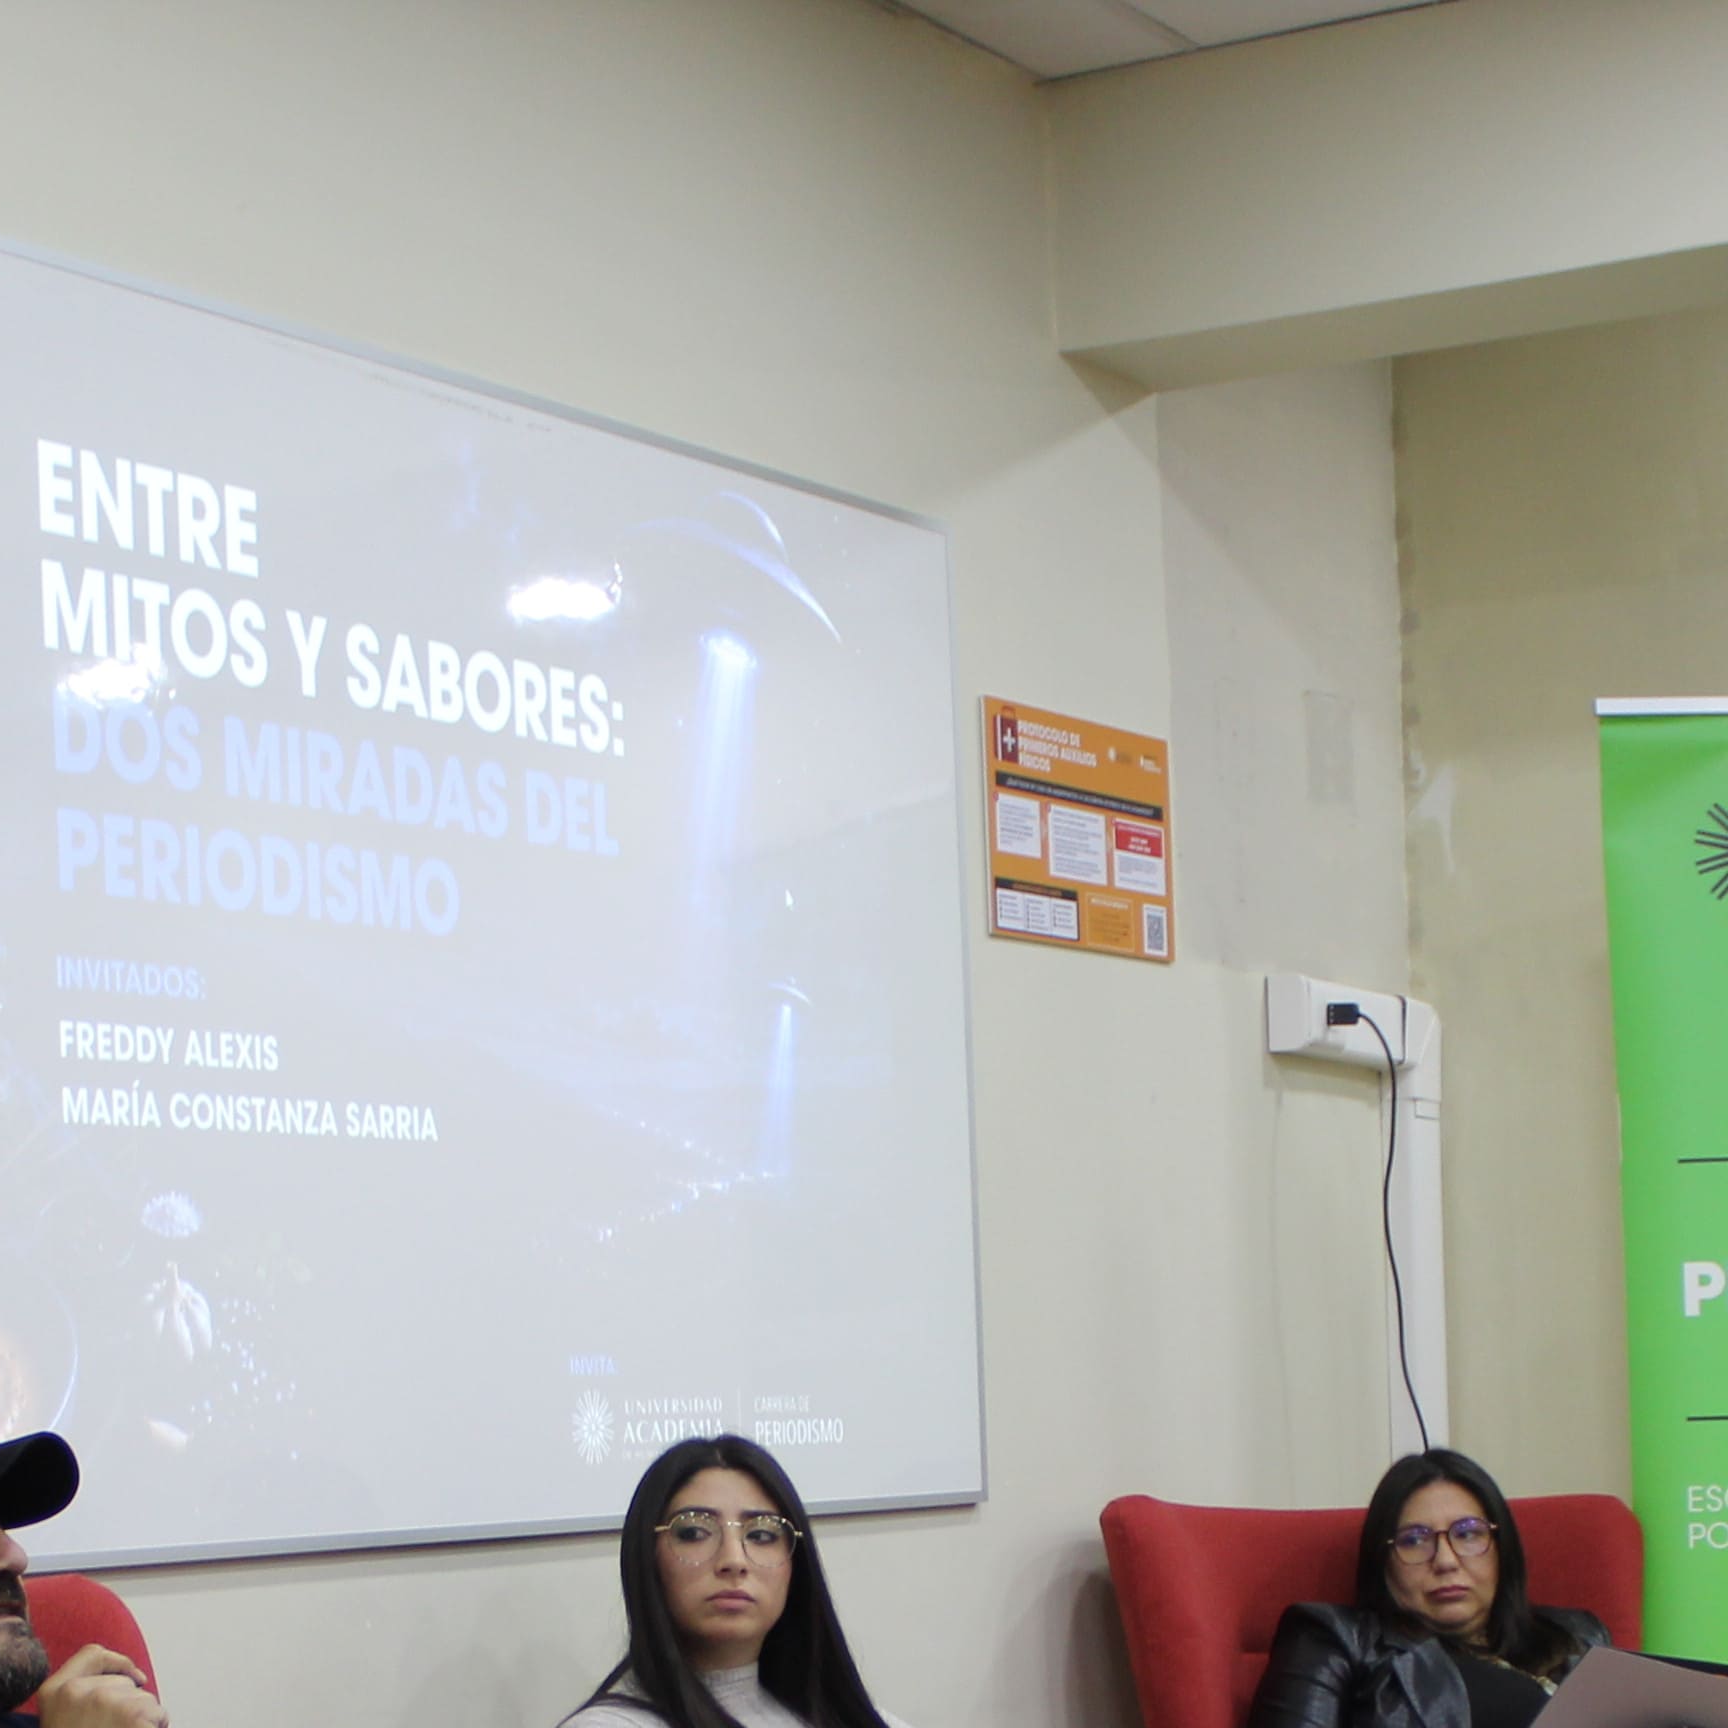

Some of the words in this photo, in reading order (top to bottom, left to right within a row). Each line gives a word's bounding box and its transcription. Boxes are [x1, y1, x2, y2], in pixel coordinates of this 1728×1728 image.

[37, 438, 260, 578] ENTRE
[40, 558, 269, 688] MITOS
[286, 610, 327, 698] Y
[345, 623, 625, 757] SABORES:
[53, 692, 203, 790] DOS
[224, 714, 509, 839] MIRADAS
[525, 768, 620, 857] DEL
[57, 807, 460, 936] PERIODISMO
[60, 1019, 174, 1064] FREDDY
[184, 1029, 279, 1071] ALEXIS
[62, 1080, 161, 1127] MARÍA
[170, 1092, 338, 1137] CONSTANZA
[345, 1103, 438, 1141] SARRIA
[623, 1418, 724, 1444] ACADEMIA
[755, 1417, 845, 1446] PERIODISMO
[624, 1398, 723, 1416] UNIVERSIDAD
